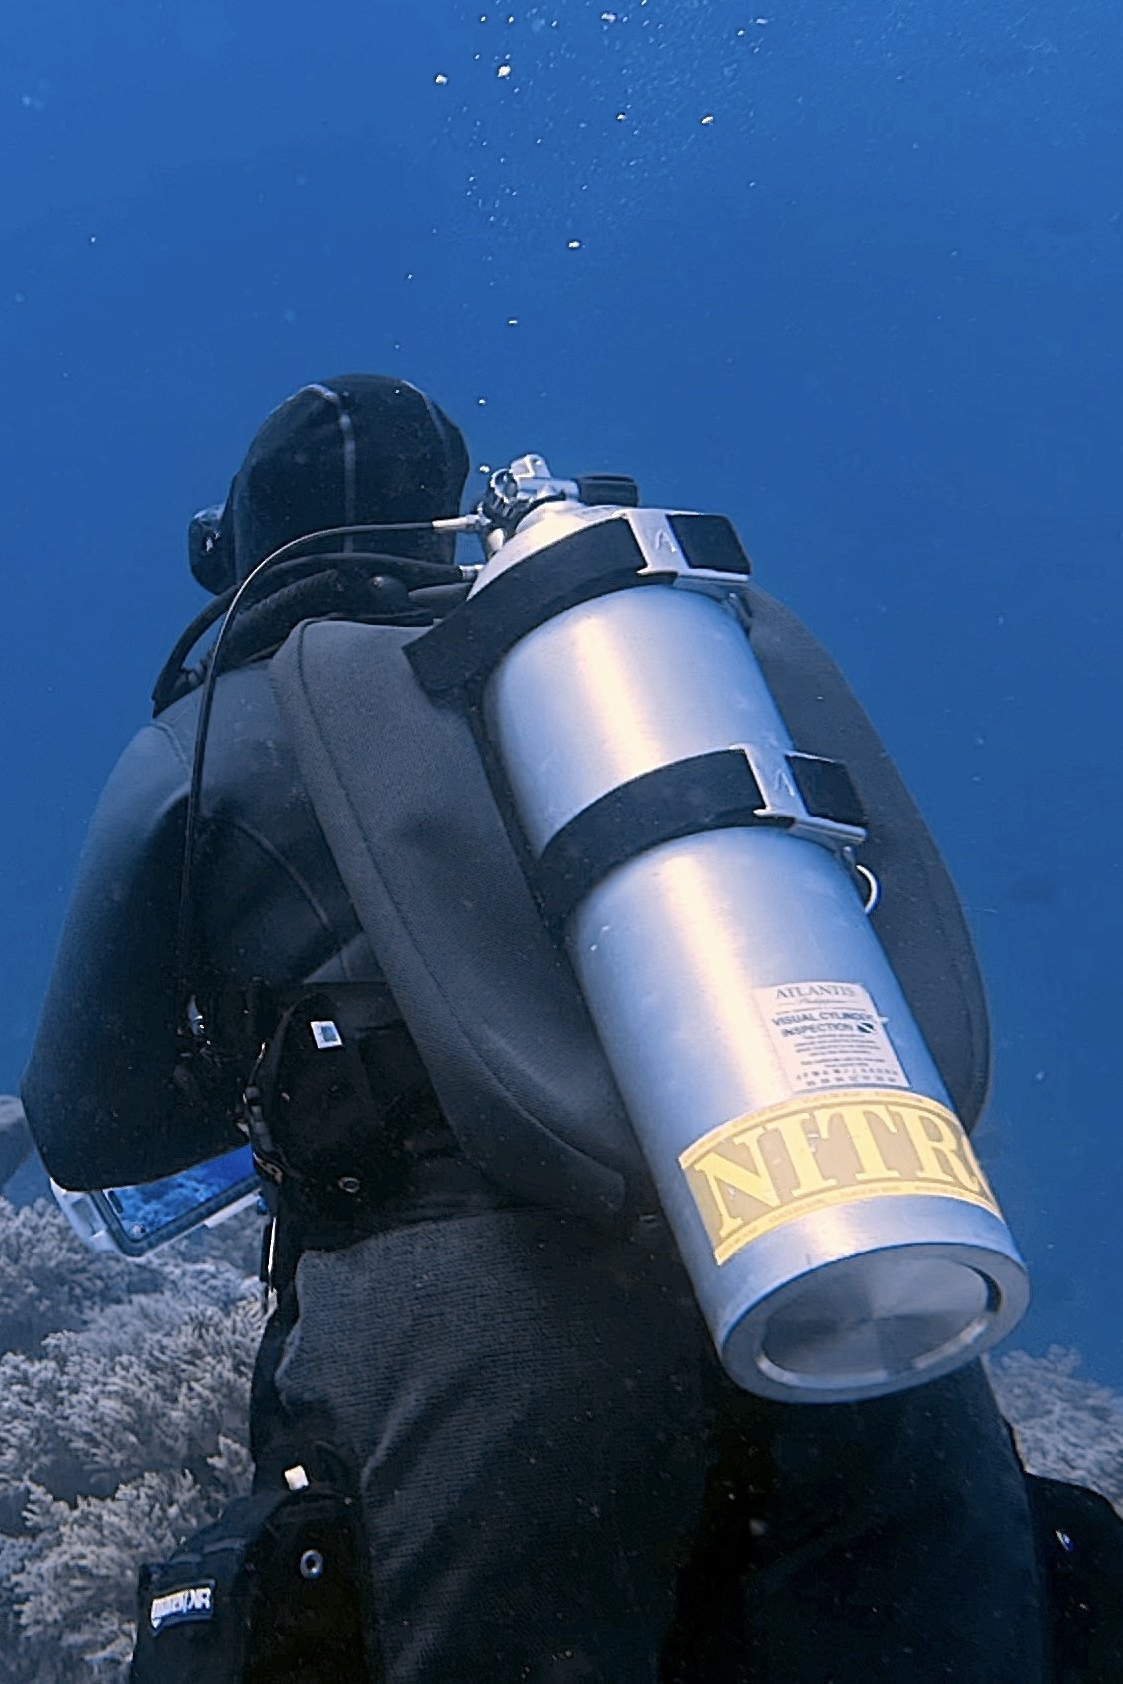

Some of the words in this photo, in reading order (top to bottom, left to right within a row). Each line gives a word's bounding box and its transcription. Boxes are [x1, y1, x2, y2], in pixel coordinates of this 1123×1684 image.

[776, 984, 855, 999] ATLANTIS
[772, 1013, 817, 1026] VISUAL
[781, 1022, 854, 1037] INSPECTION
[694, 1104, 990, 1238] NITR
